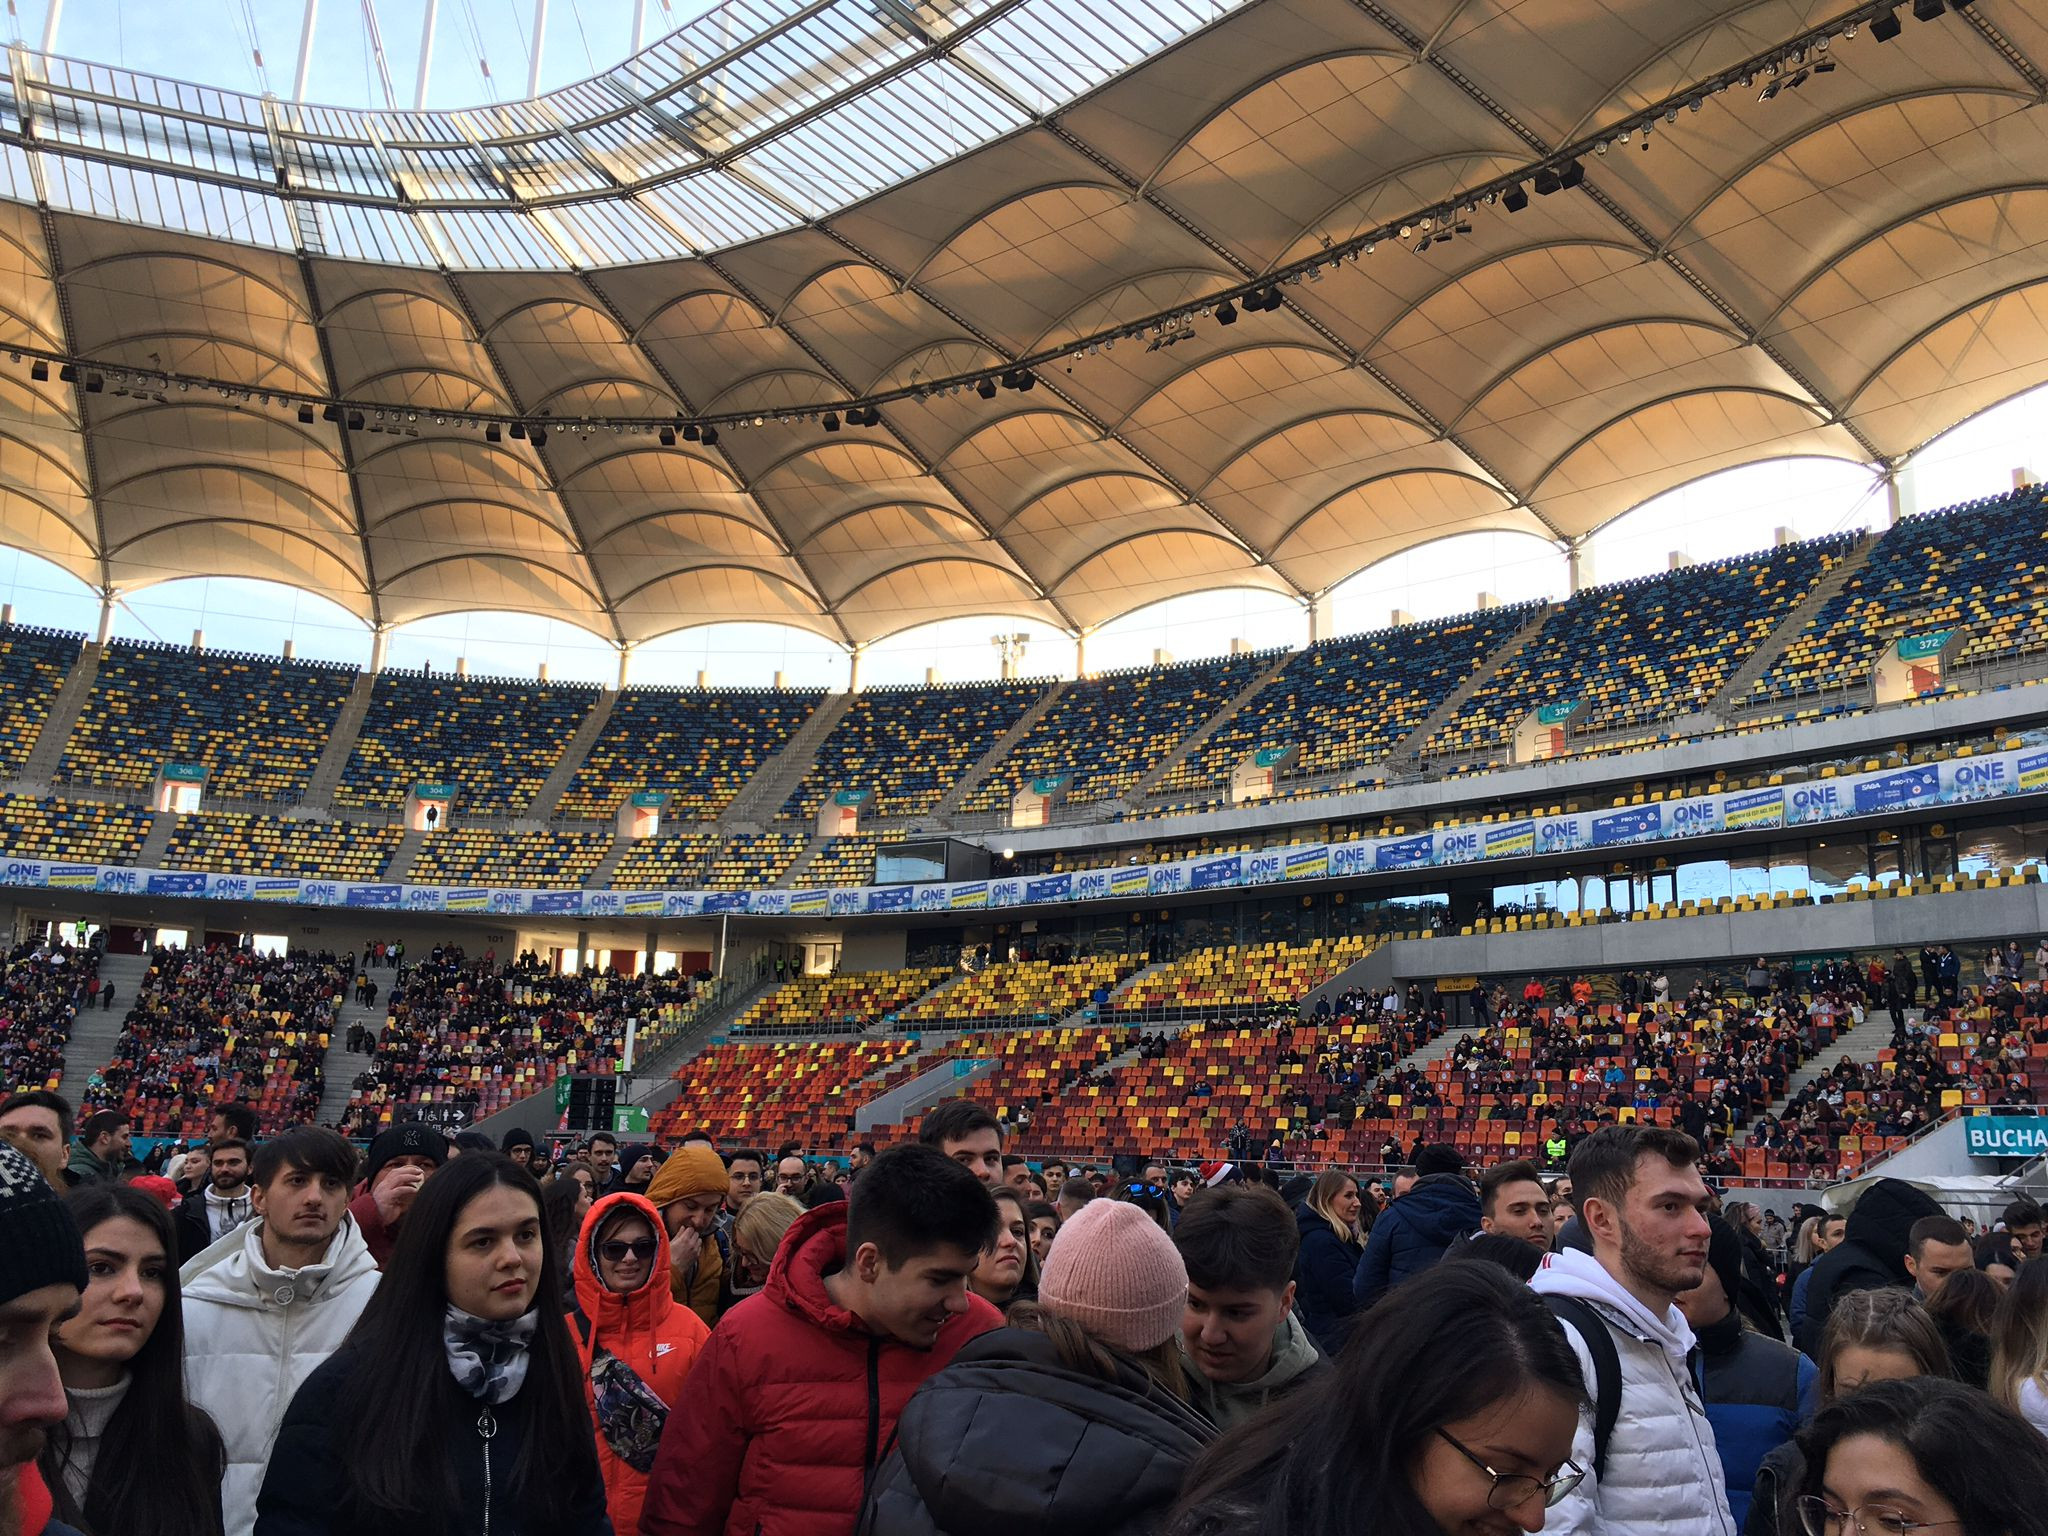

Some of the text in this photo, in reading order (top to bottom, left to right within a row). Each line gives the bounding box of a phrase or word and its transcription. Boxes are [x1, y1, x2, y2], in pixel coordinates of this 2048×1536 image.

[1920, 640, 1938, 649] 372
[2020, 760, 2036, 769] THANK
[1955, 762, 2004, 786] ONE
[1862, 782, 1880, 791] SAGA
[1793, 786, 1836, 809] ONE
[1674, 803, 1713, 824] ONE
[1542, 821, 1578, 839] ONE
[1444, 834, 1476, 851] ONE
[1334, 847, 1364, 863] ONE
[8, 864, 41, 877] ONE
[1250, 858, 1278, 872] ONE
[104, 871, 136, 884] ONE
[1080, 874, 1104, 888] ONE
[1154, 868, 1181, 882] ONE
[216, 879, 247, 891] ONE
[306, 884, 336, 896] ONE
[993, 882, 1018, 896] ONE
[411, 890, 440, 902] ONE
[494, 892, 522, 904] ONE
[759, 894, 785, 906] ONE
[834, 893, 858, 904] ONE
[921, 888, 946, 900] ONE
[592, 895, 618, 906] ONE
[668, 896, 694, 906] ONE
[1970, 1130, 2048, 1148] BUCHA
[656, 1343, 671, 1352] NIKE
